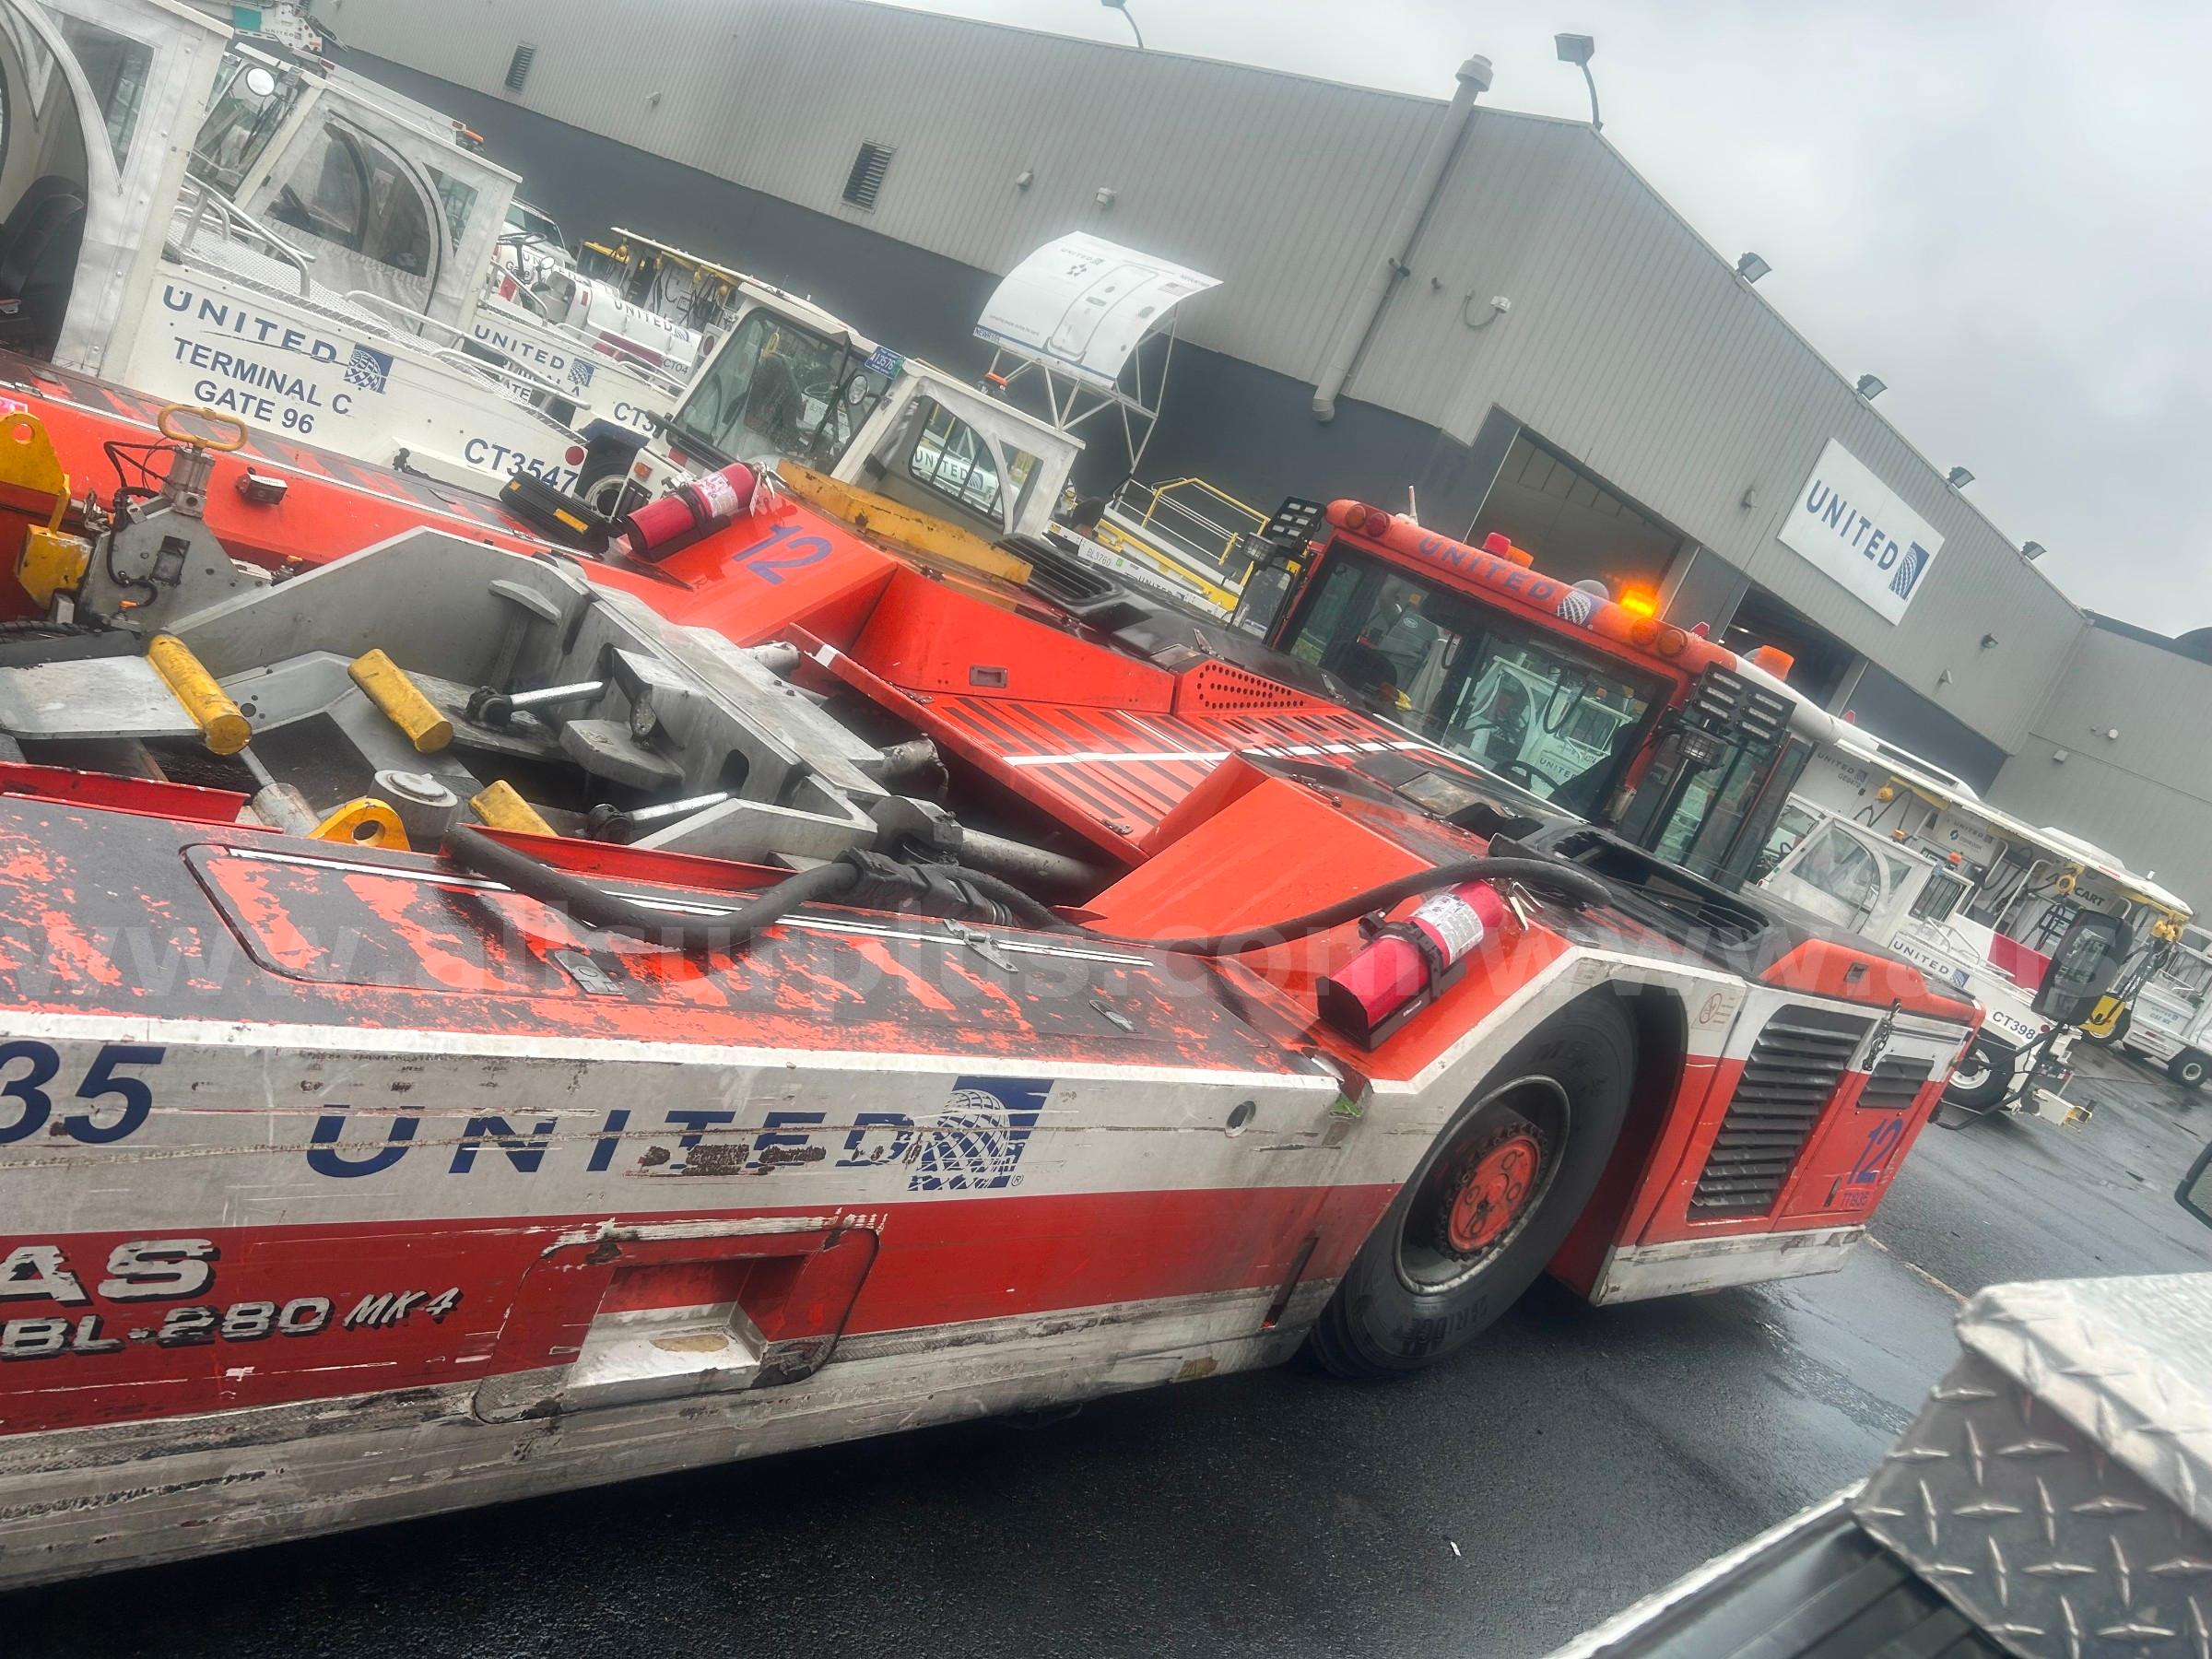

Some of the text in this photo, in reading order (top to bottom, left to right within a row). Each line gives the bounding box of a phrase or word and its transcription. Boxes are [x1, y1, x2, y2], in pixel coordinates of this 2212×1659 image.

[163, 285, 337, 363] UNITED
[475, 324, 565, 370] UNITED
[174, 336, 353, 414] TERMINAL C
[194, 380, 315, 434] GATE 96
[915, 450, 968, 479] UNTED
[732, 524, 833, 585] 12
[1806, 479, 1899, 571] UNITED
[1418, 535, 1556, 599] UNITED
[1818, 751, 1855, 774] UNITED
[2074, 886, 2106, 907] CART
[1893, 940, 1949, 975] UNITED
[1993, 1011, 2036, 1040] CT398
[0, 1040, 167, 1145] 35
[306, 1103, 919, 1179] UNITED
[1846, 1117, 1903, 1185] 12
